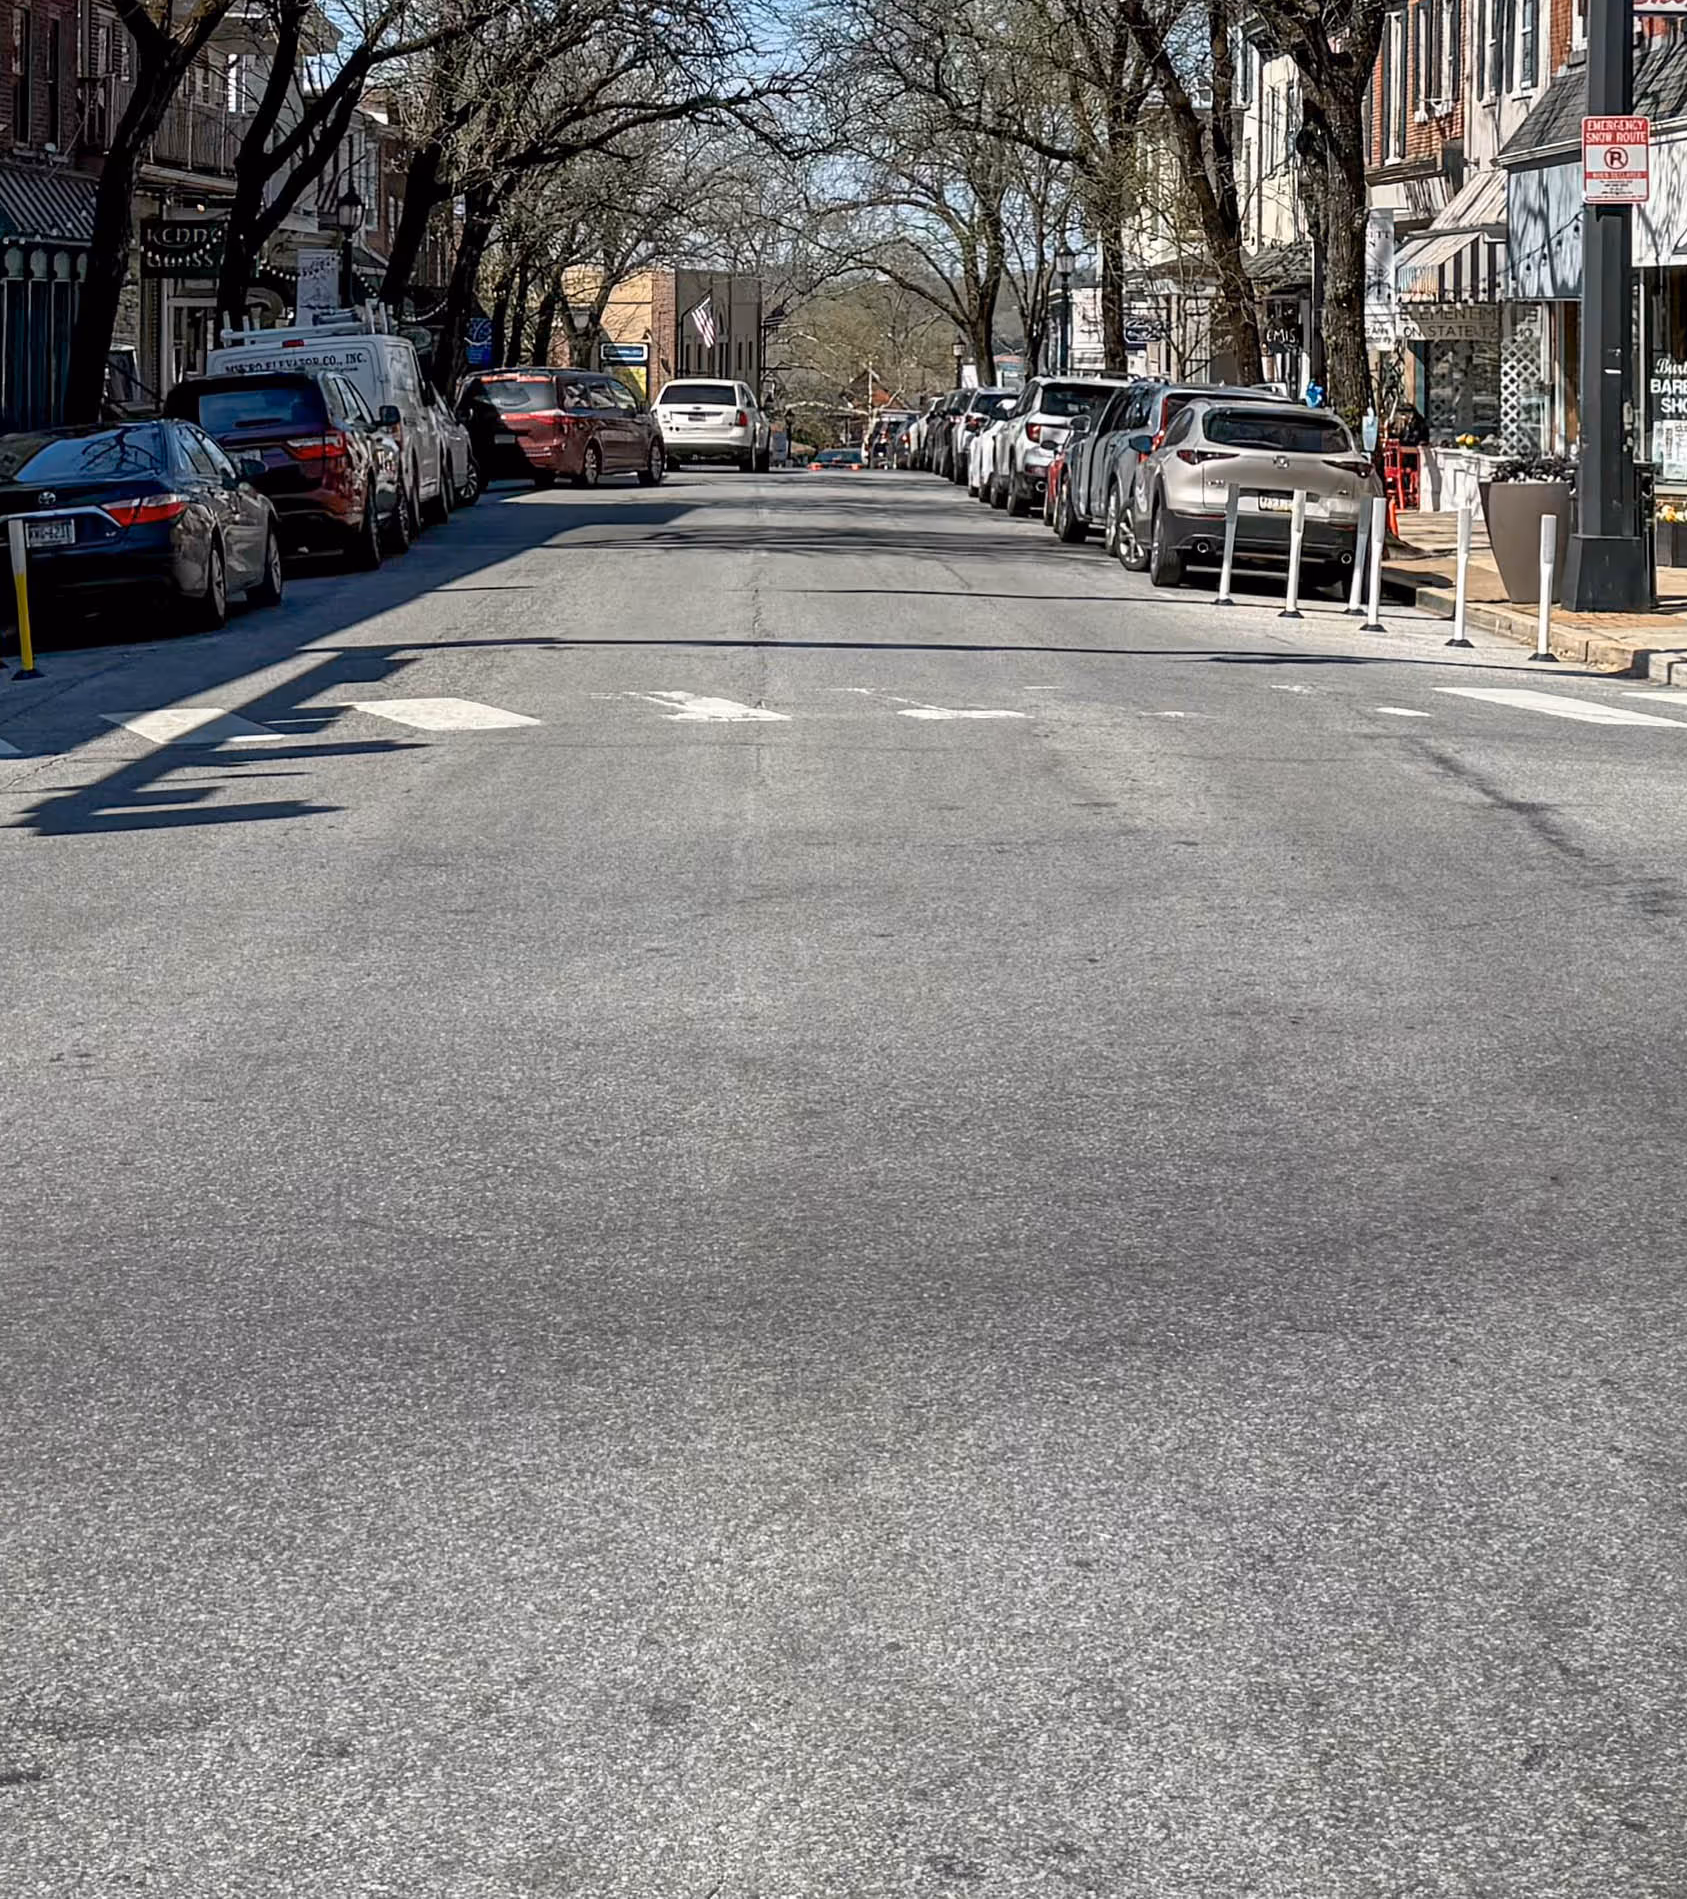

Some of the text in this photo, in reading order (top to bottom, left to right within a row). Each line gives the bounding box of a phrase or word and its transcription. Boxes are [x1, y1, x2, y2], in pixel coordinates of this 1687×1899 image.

[1587, 120, 1645, 131] EMERGENCY
[1586, 132, 1647, 143] SNOW ROUTE
